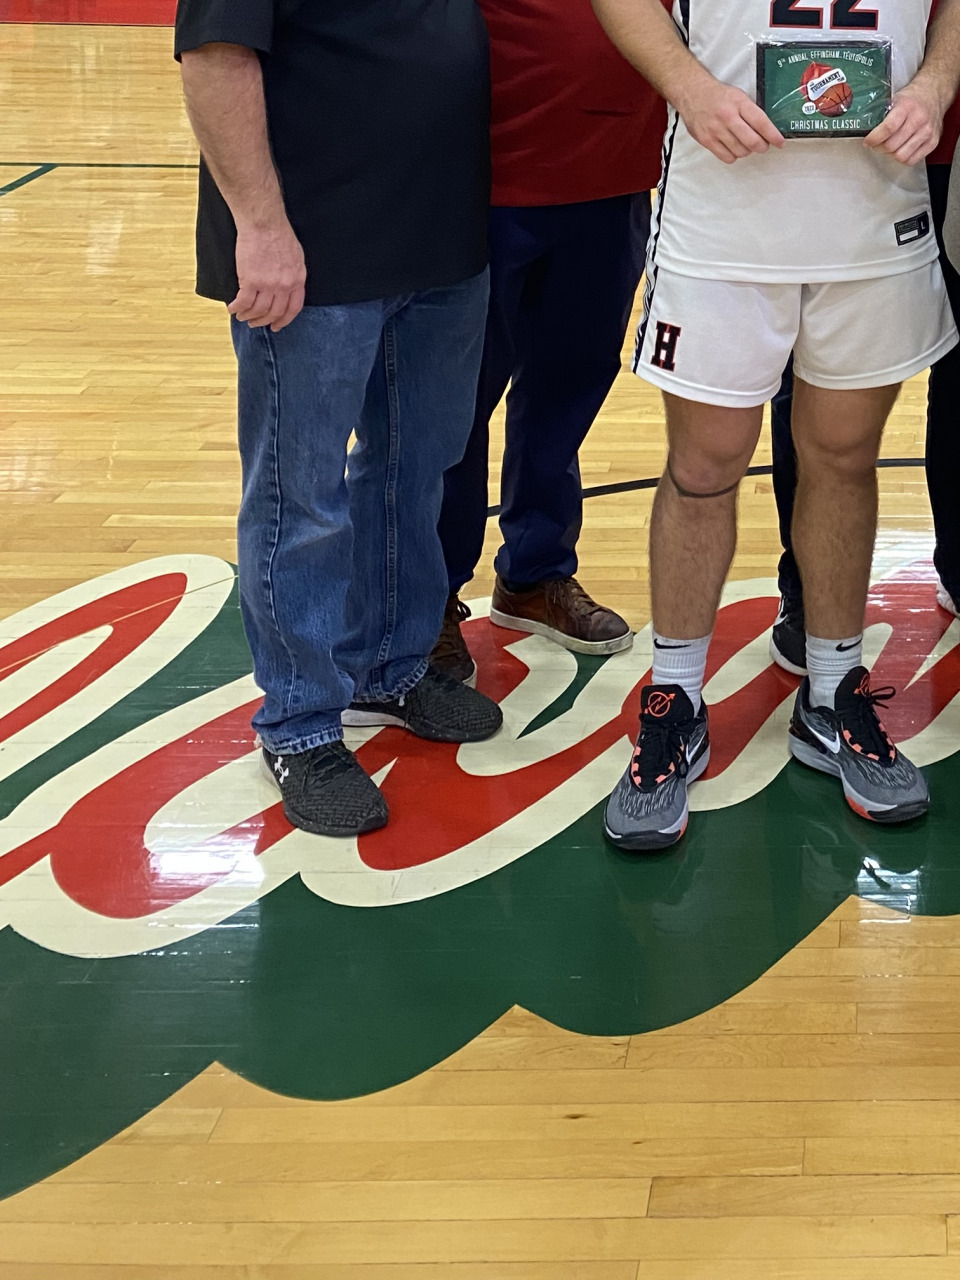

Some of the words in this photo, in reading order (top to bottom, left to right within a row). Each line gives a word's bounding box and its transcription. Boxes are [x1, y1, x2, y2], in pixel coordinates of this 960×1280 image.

[788, 53, 808, 64] ANNUAL
[810, 71, 841, 93] TOURNAMENT
[790, 120, 828, 130] CHRISTMAS
[833, 120, 861, 129] CLASSIC
[650, 320, 682, 373] H
